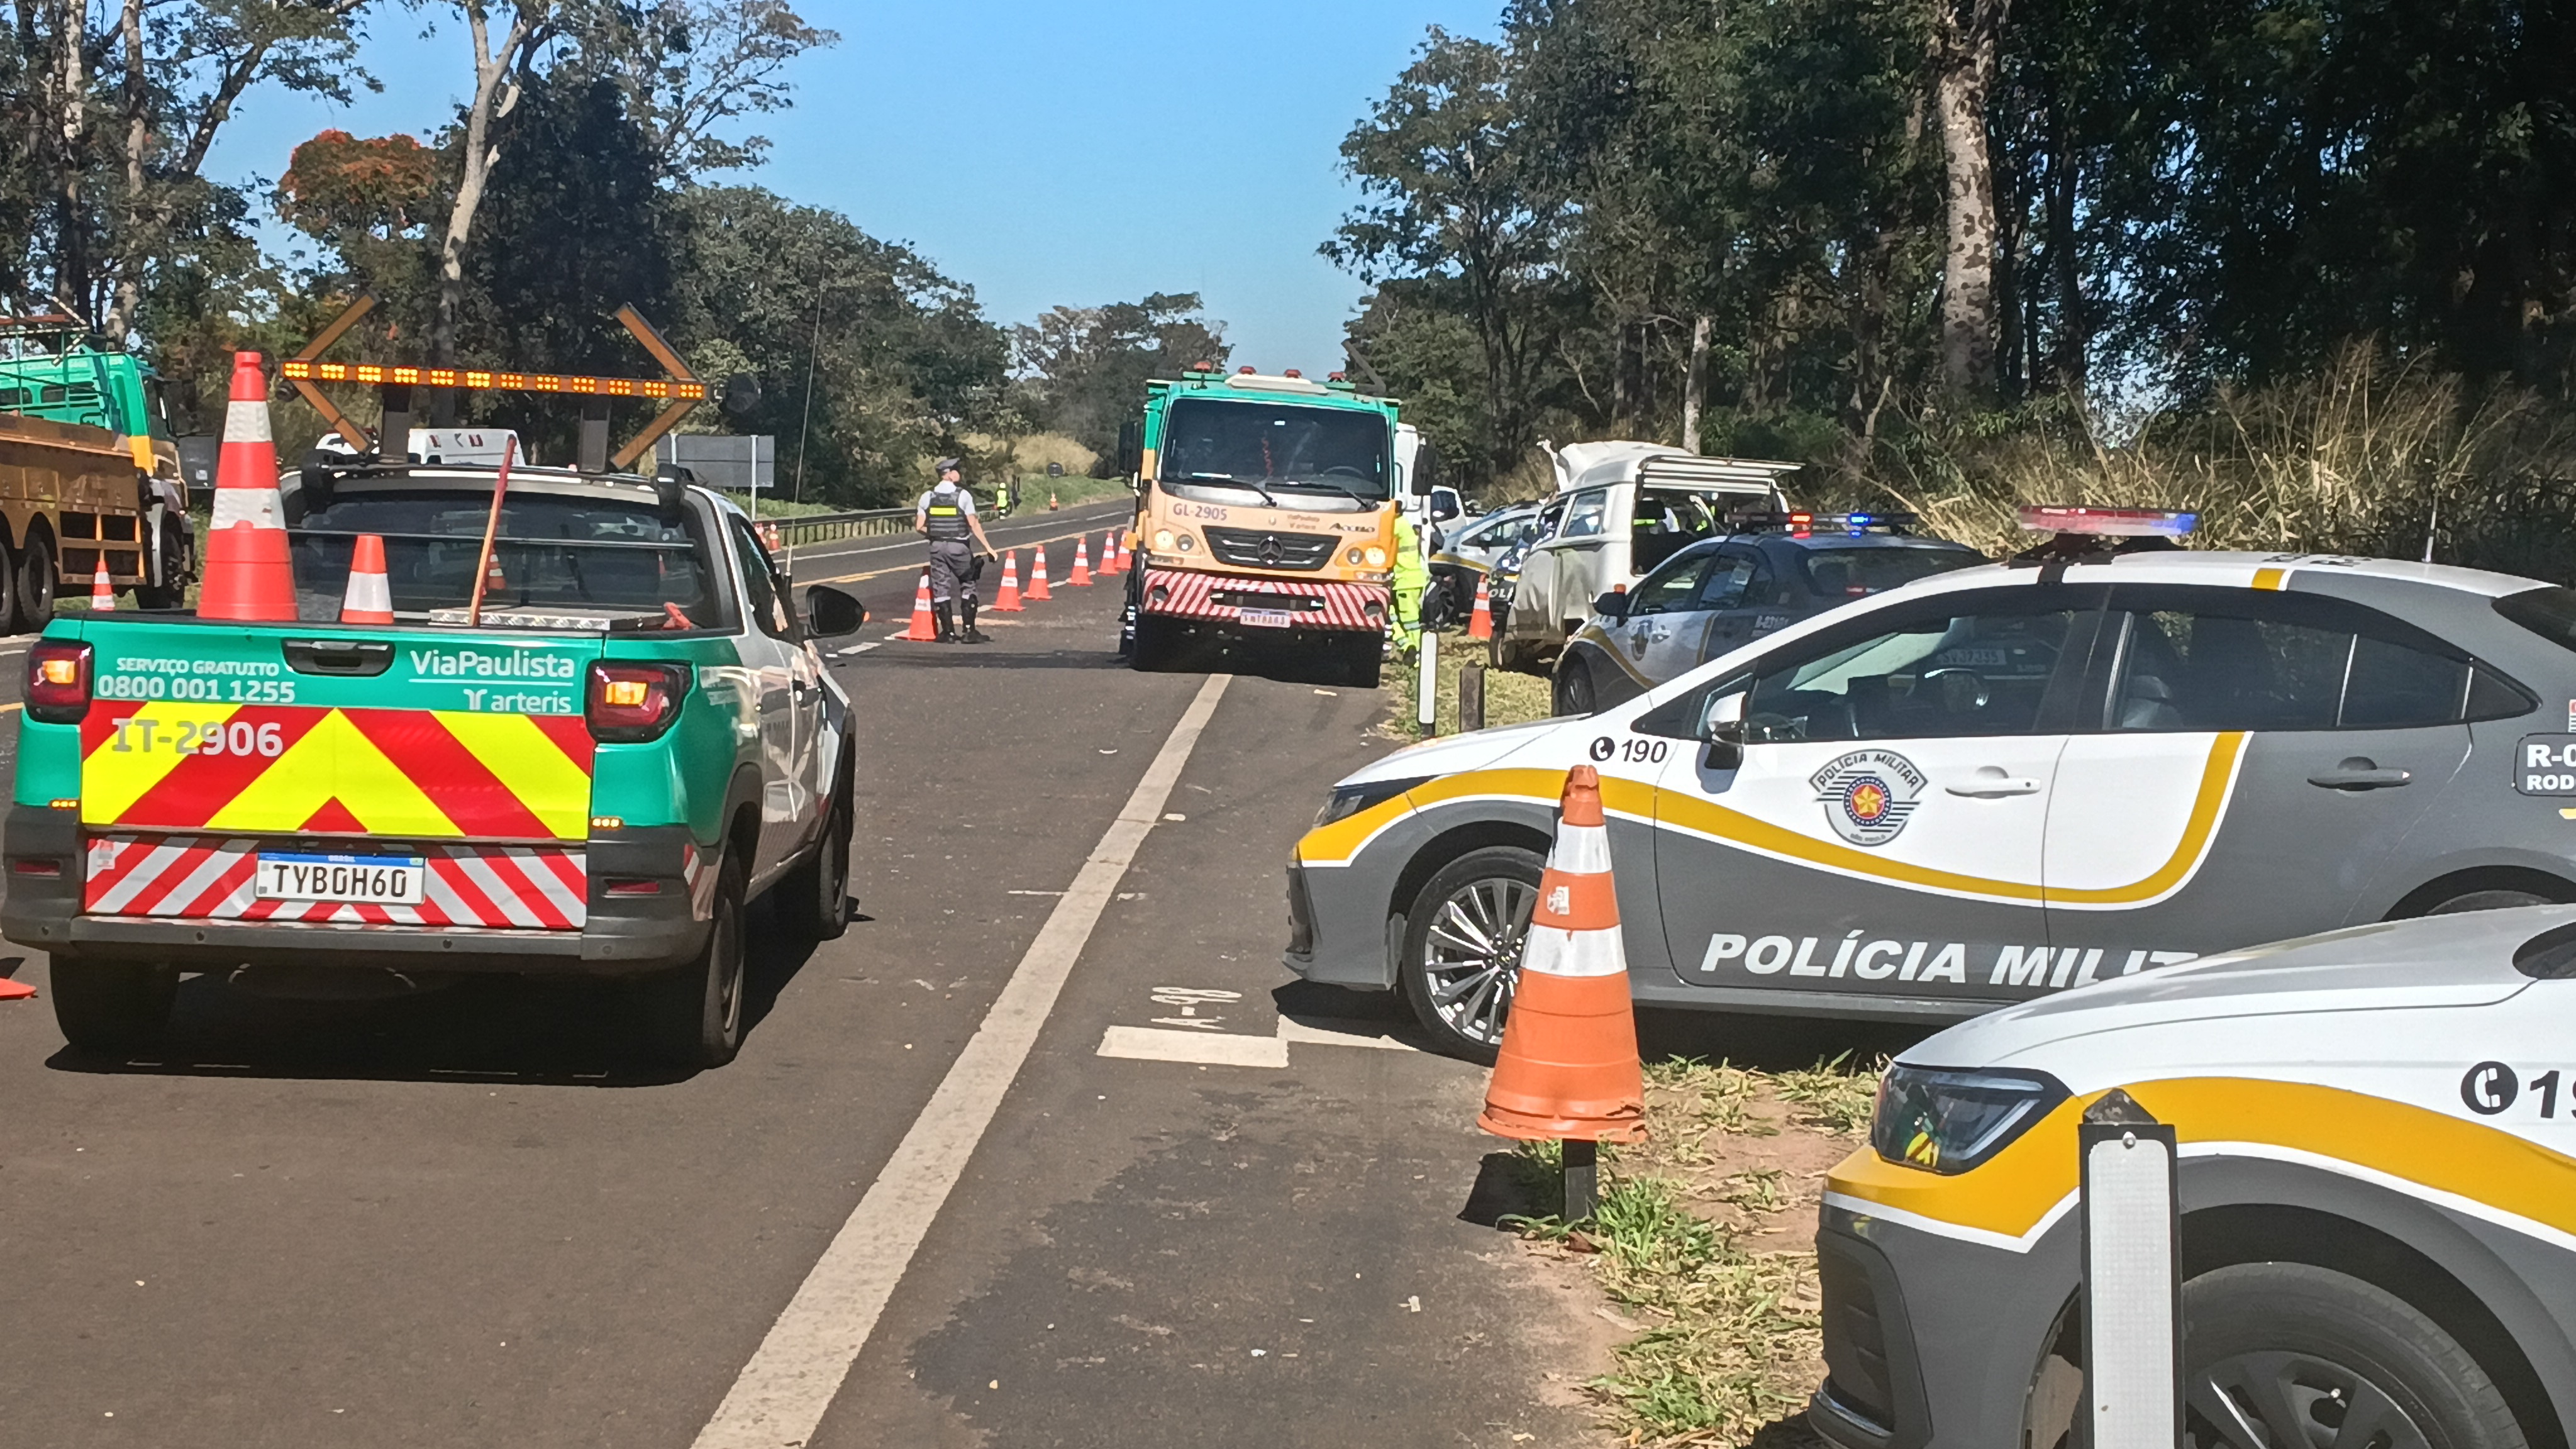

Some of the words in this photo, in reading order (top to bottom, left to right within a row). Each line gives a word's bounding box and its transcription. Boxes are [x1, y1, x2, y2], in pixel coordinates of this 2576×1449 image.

[1172, 502, 1228, 521] GL-2905
[116, 658, 189, 677] SERVIÇO
[192, 660, 280, 677] GRATUITO
[410, 650, 574, 677] ViaPaulista
[98, 675, 165, 698] 0800
[172, 677, 221, 701] 001
[229, 681, 296, 703] 1255
[491, 691, 572, 714] arteris
[111, 718, 283, 757] IT-2906
[1621, 739, 1668, 763] 190
[1817, 753, 1868, 787] POLÍCIA
[1874, 753, 1919, 788] MILITAR
[2527, 774, 2576, 791] ROD
[274, 864, 407, 897] TYB0H60
[1701, 930, 1967, 984] POLÍCIA
[2529, 1070, 2576, 1119] 1
